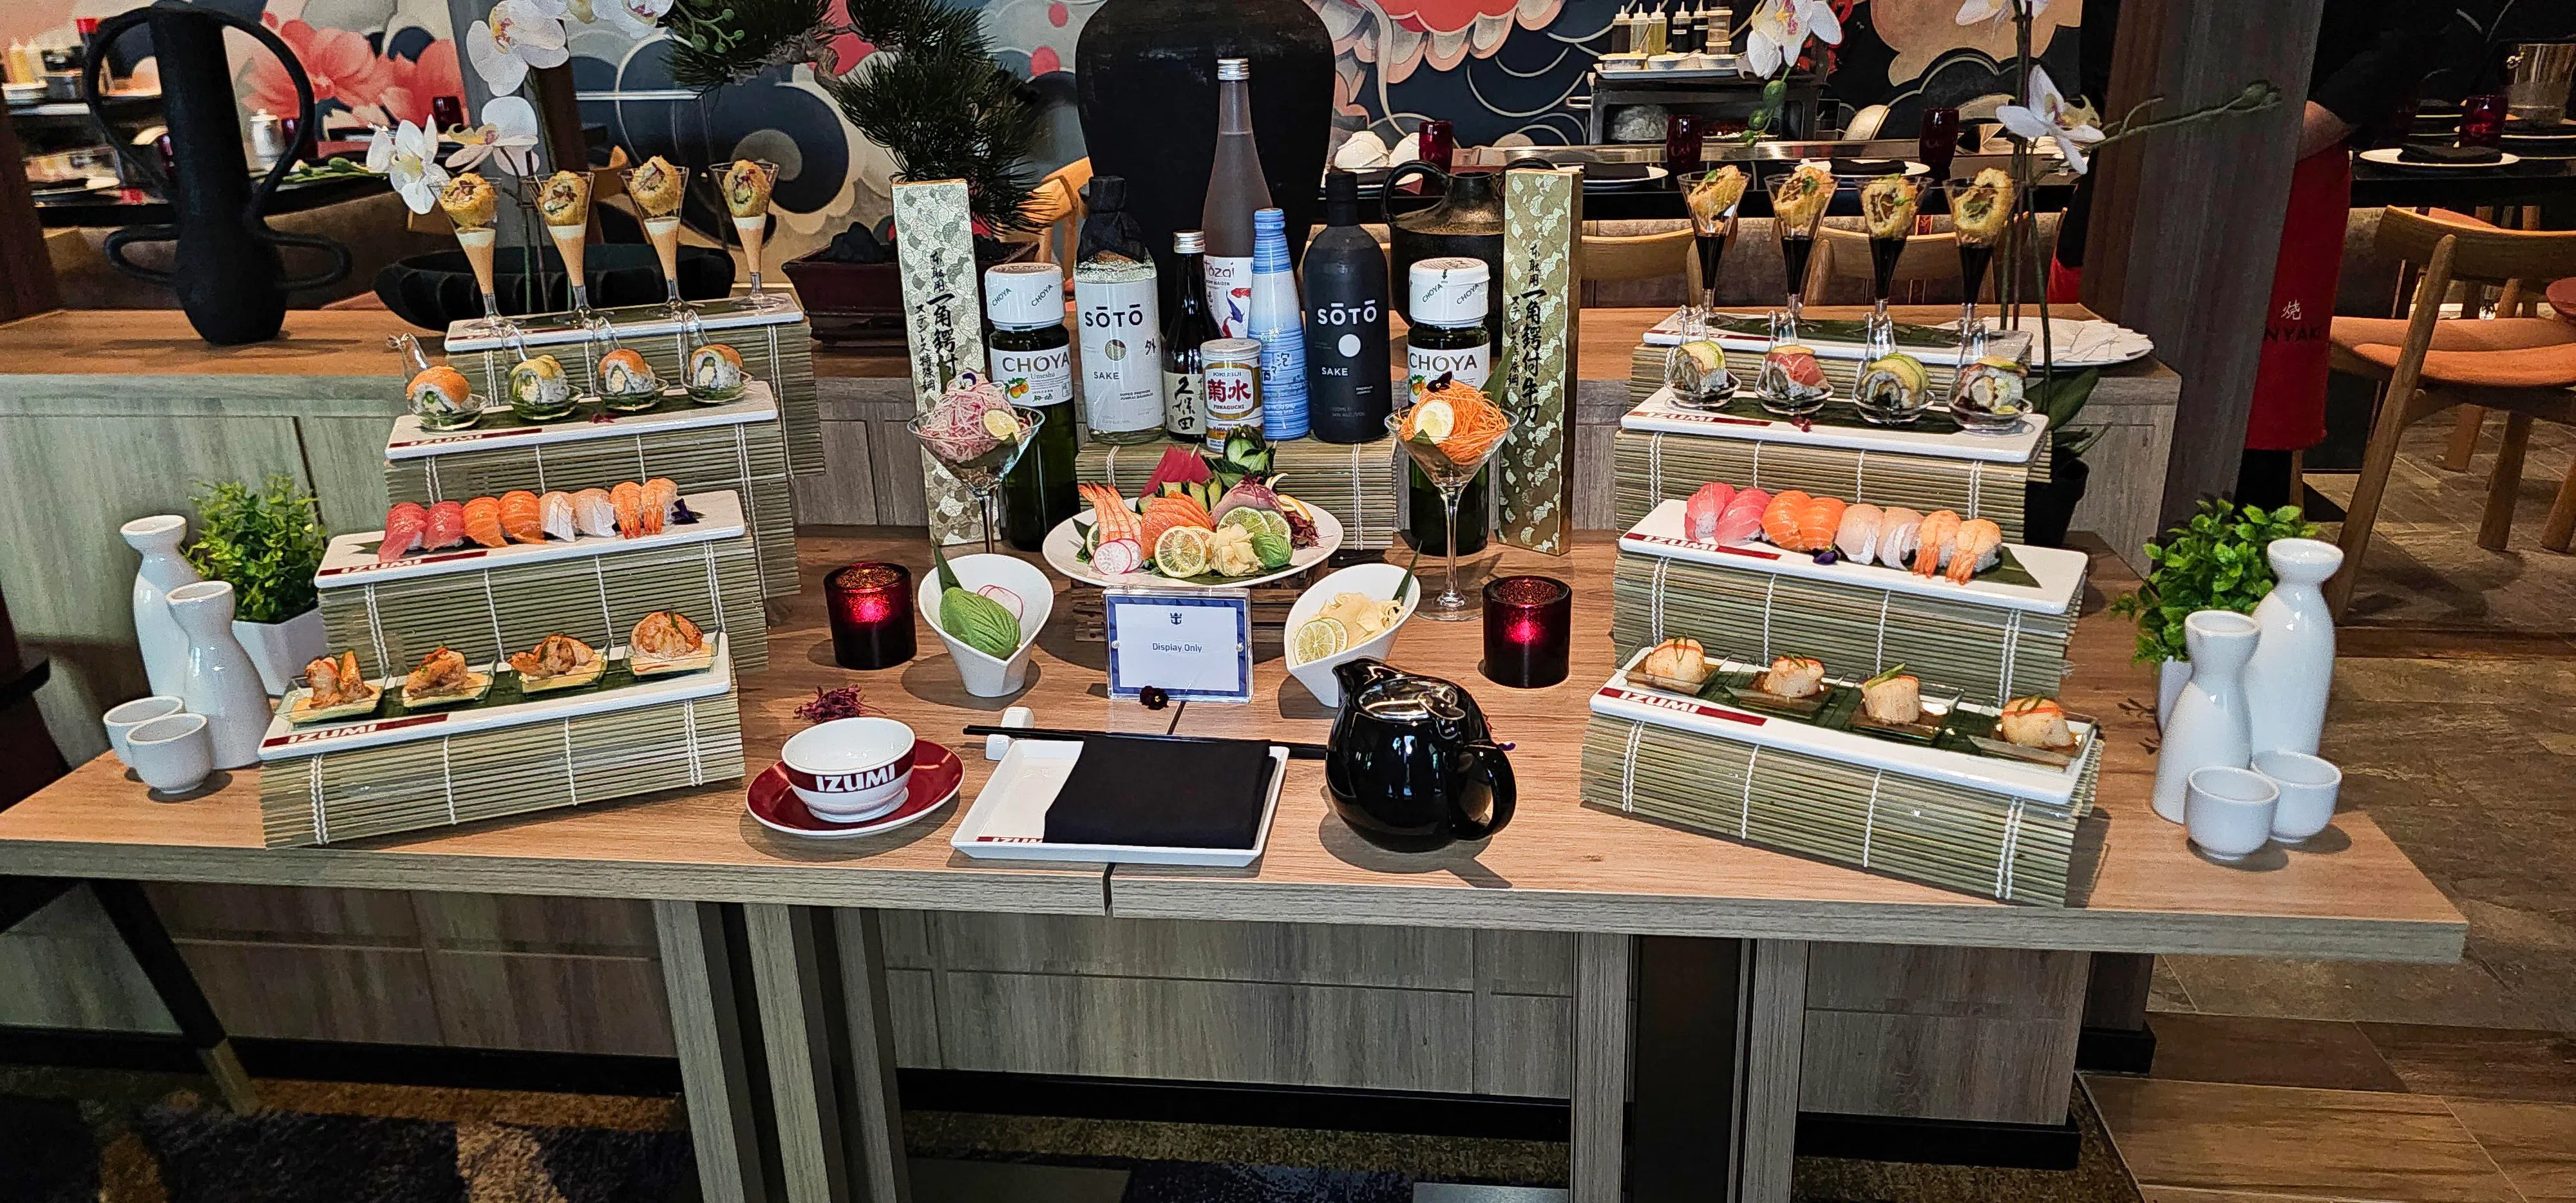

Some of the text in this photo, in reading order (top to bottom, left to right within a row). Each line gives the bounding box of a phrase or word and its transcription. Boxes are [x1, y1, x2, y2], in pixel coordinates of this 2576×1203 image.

[992, 288, 1012, 307] CHOYA
[1031, 284, 1054, 307] CHOYA
[1422, 283, 1443, 303] CHOYA
[1456, 283, 1479, 305] CHOYA
[1145, 338, 1157, 355] 外
[1002, 351, 1070, 372] CHOYA
[1321, 366, 1349, 376] SAKE
[1409, 352, 1477, 372] CHOYA
[1094, 371, 1120, 380] SAKE
[1208, 378, 1251, 403] 菊水
[1647, 412, 1715, 422] IZUMI
[410, 434, 482, 446] IZUMI
[1643, 536, 1719, 551] IZUMI
[341, 559, 422, 573] IZUMI
[1152, 643, 1202, 653] Display Only
[1619, 691, 1700, 713] IZUMI
[288, 724, 377, 744] IZUMI
[815, 763, 895, 792] IZUMI
